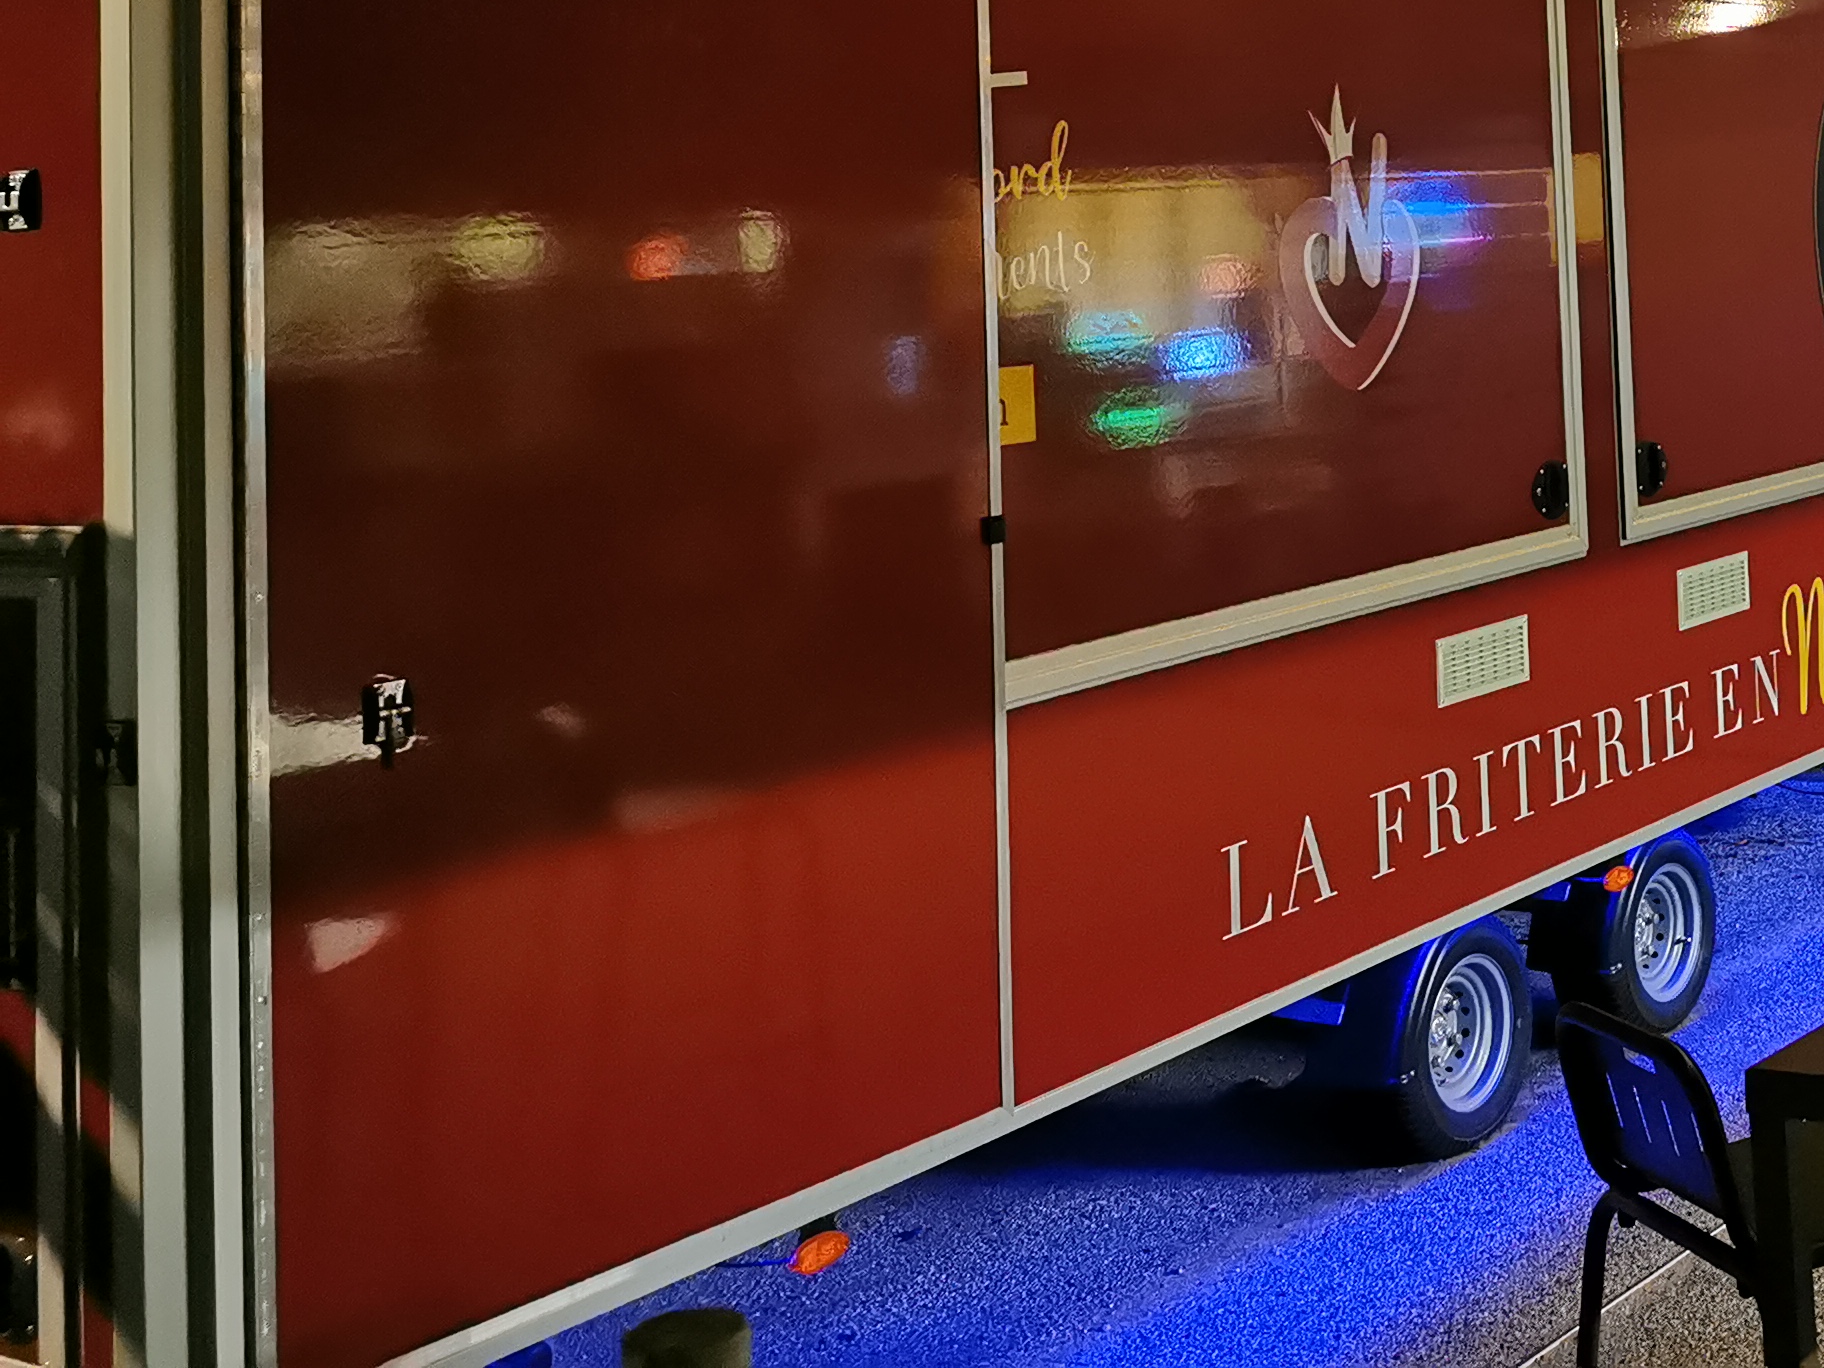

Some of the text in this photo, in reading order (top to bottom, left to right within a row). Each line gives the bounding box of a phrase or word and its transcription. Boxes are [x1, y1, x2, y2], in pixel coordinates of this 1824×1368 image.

[993, 120, 1072, 203] ord
[994, 231, 1096, 300] ents
[1221, 814, 1338, 941] LA
[1369, 680, 1696, 881] FRITERIE
[1710, 649, 1785, 738] EN
